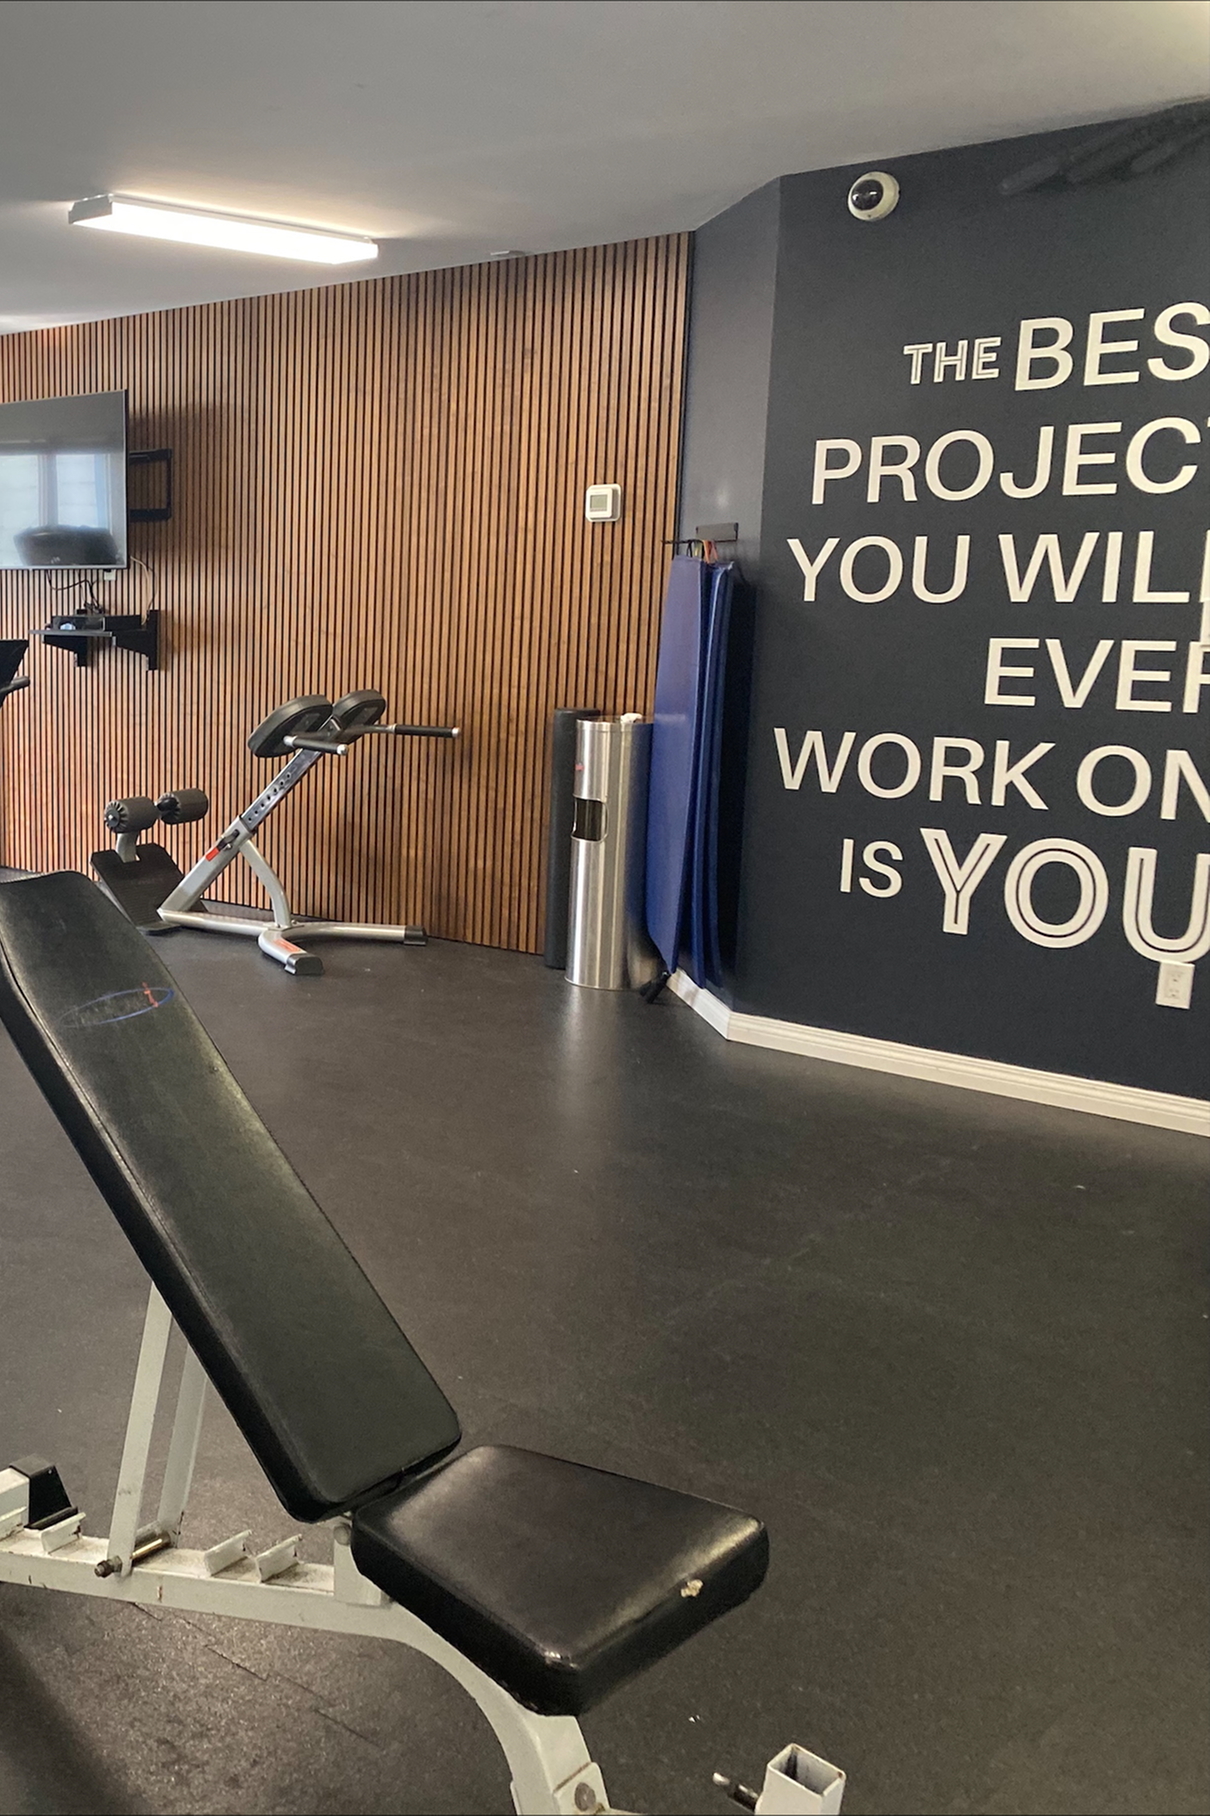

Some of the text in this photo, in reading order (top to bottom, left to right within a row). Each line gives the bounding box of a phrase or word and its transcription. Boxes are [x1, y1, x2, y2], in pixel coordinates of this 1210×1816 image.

[902, 336, 1002, 385] THE
[811, 416, 1210, 505] PROJEC
[787, 530, 1210, 604] YOU WIL
[774, 727, 1210, 824] WORK ON
[840, 827, 1210, 963] IS YOU
